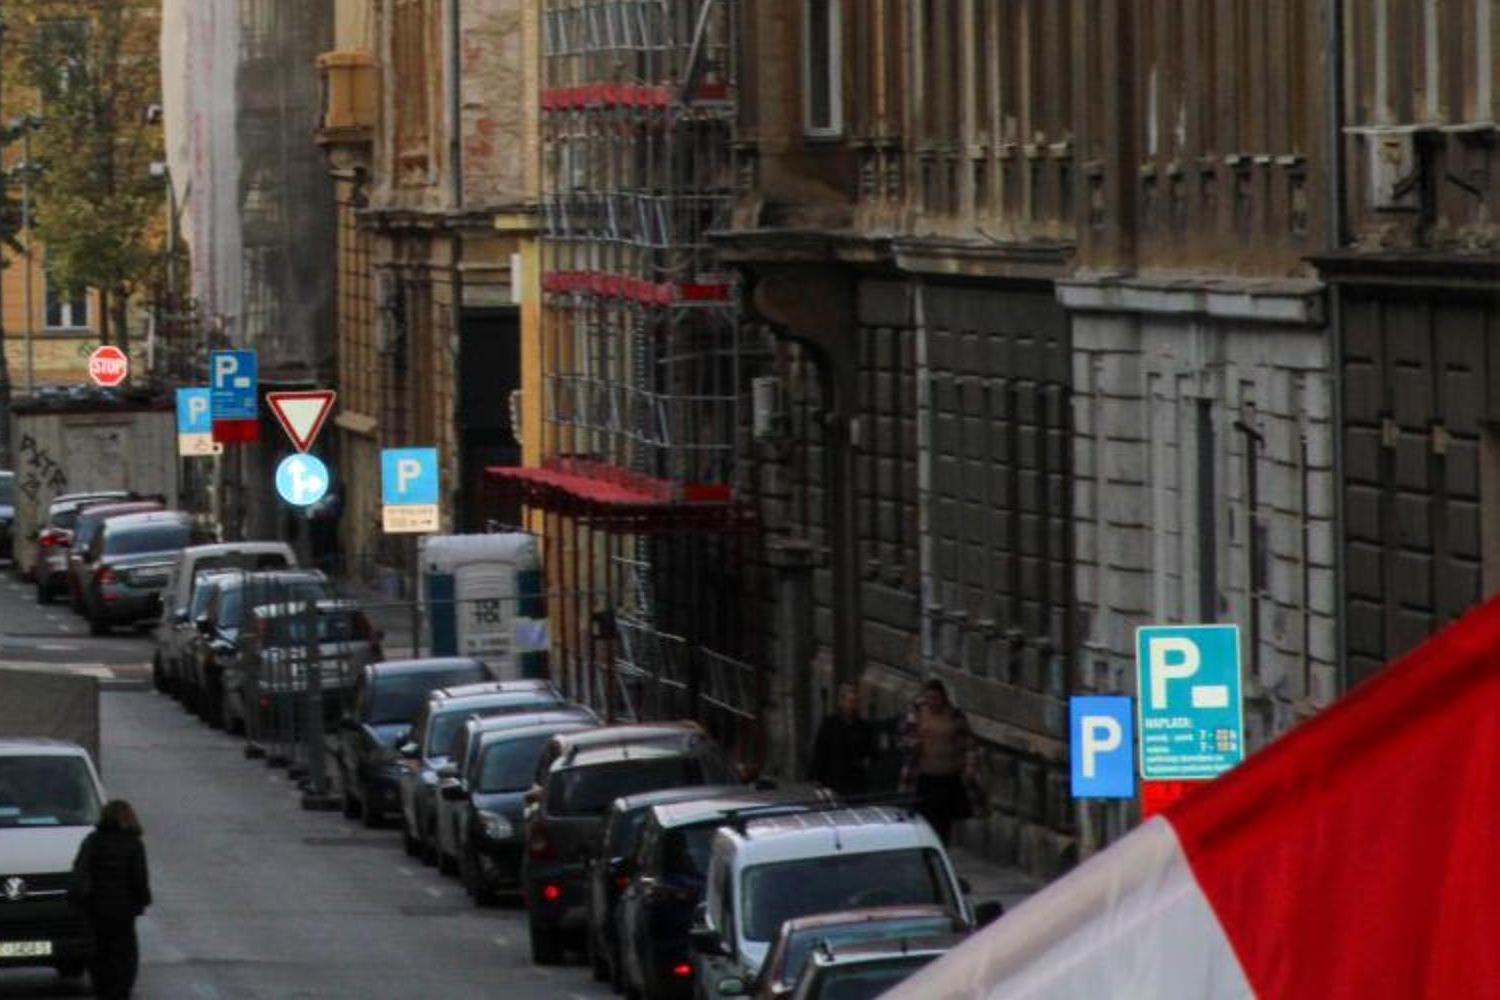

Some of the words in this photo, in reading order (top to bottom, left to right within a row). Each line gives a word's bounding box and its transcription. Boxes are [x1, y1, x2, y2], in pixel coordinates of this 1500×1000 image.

[91, 357, 126, 374] STOP
[215, 355, 239, 388] P
[189, 396, 207, 425] P
[397, 459, 420, 493] P
[1149, 637, 1200, 710] P
[1082, 715, 1122, 778] P
